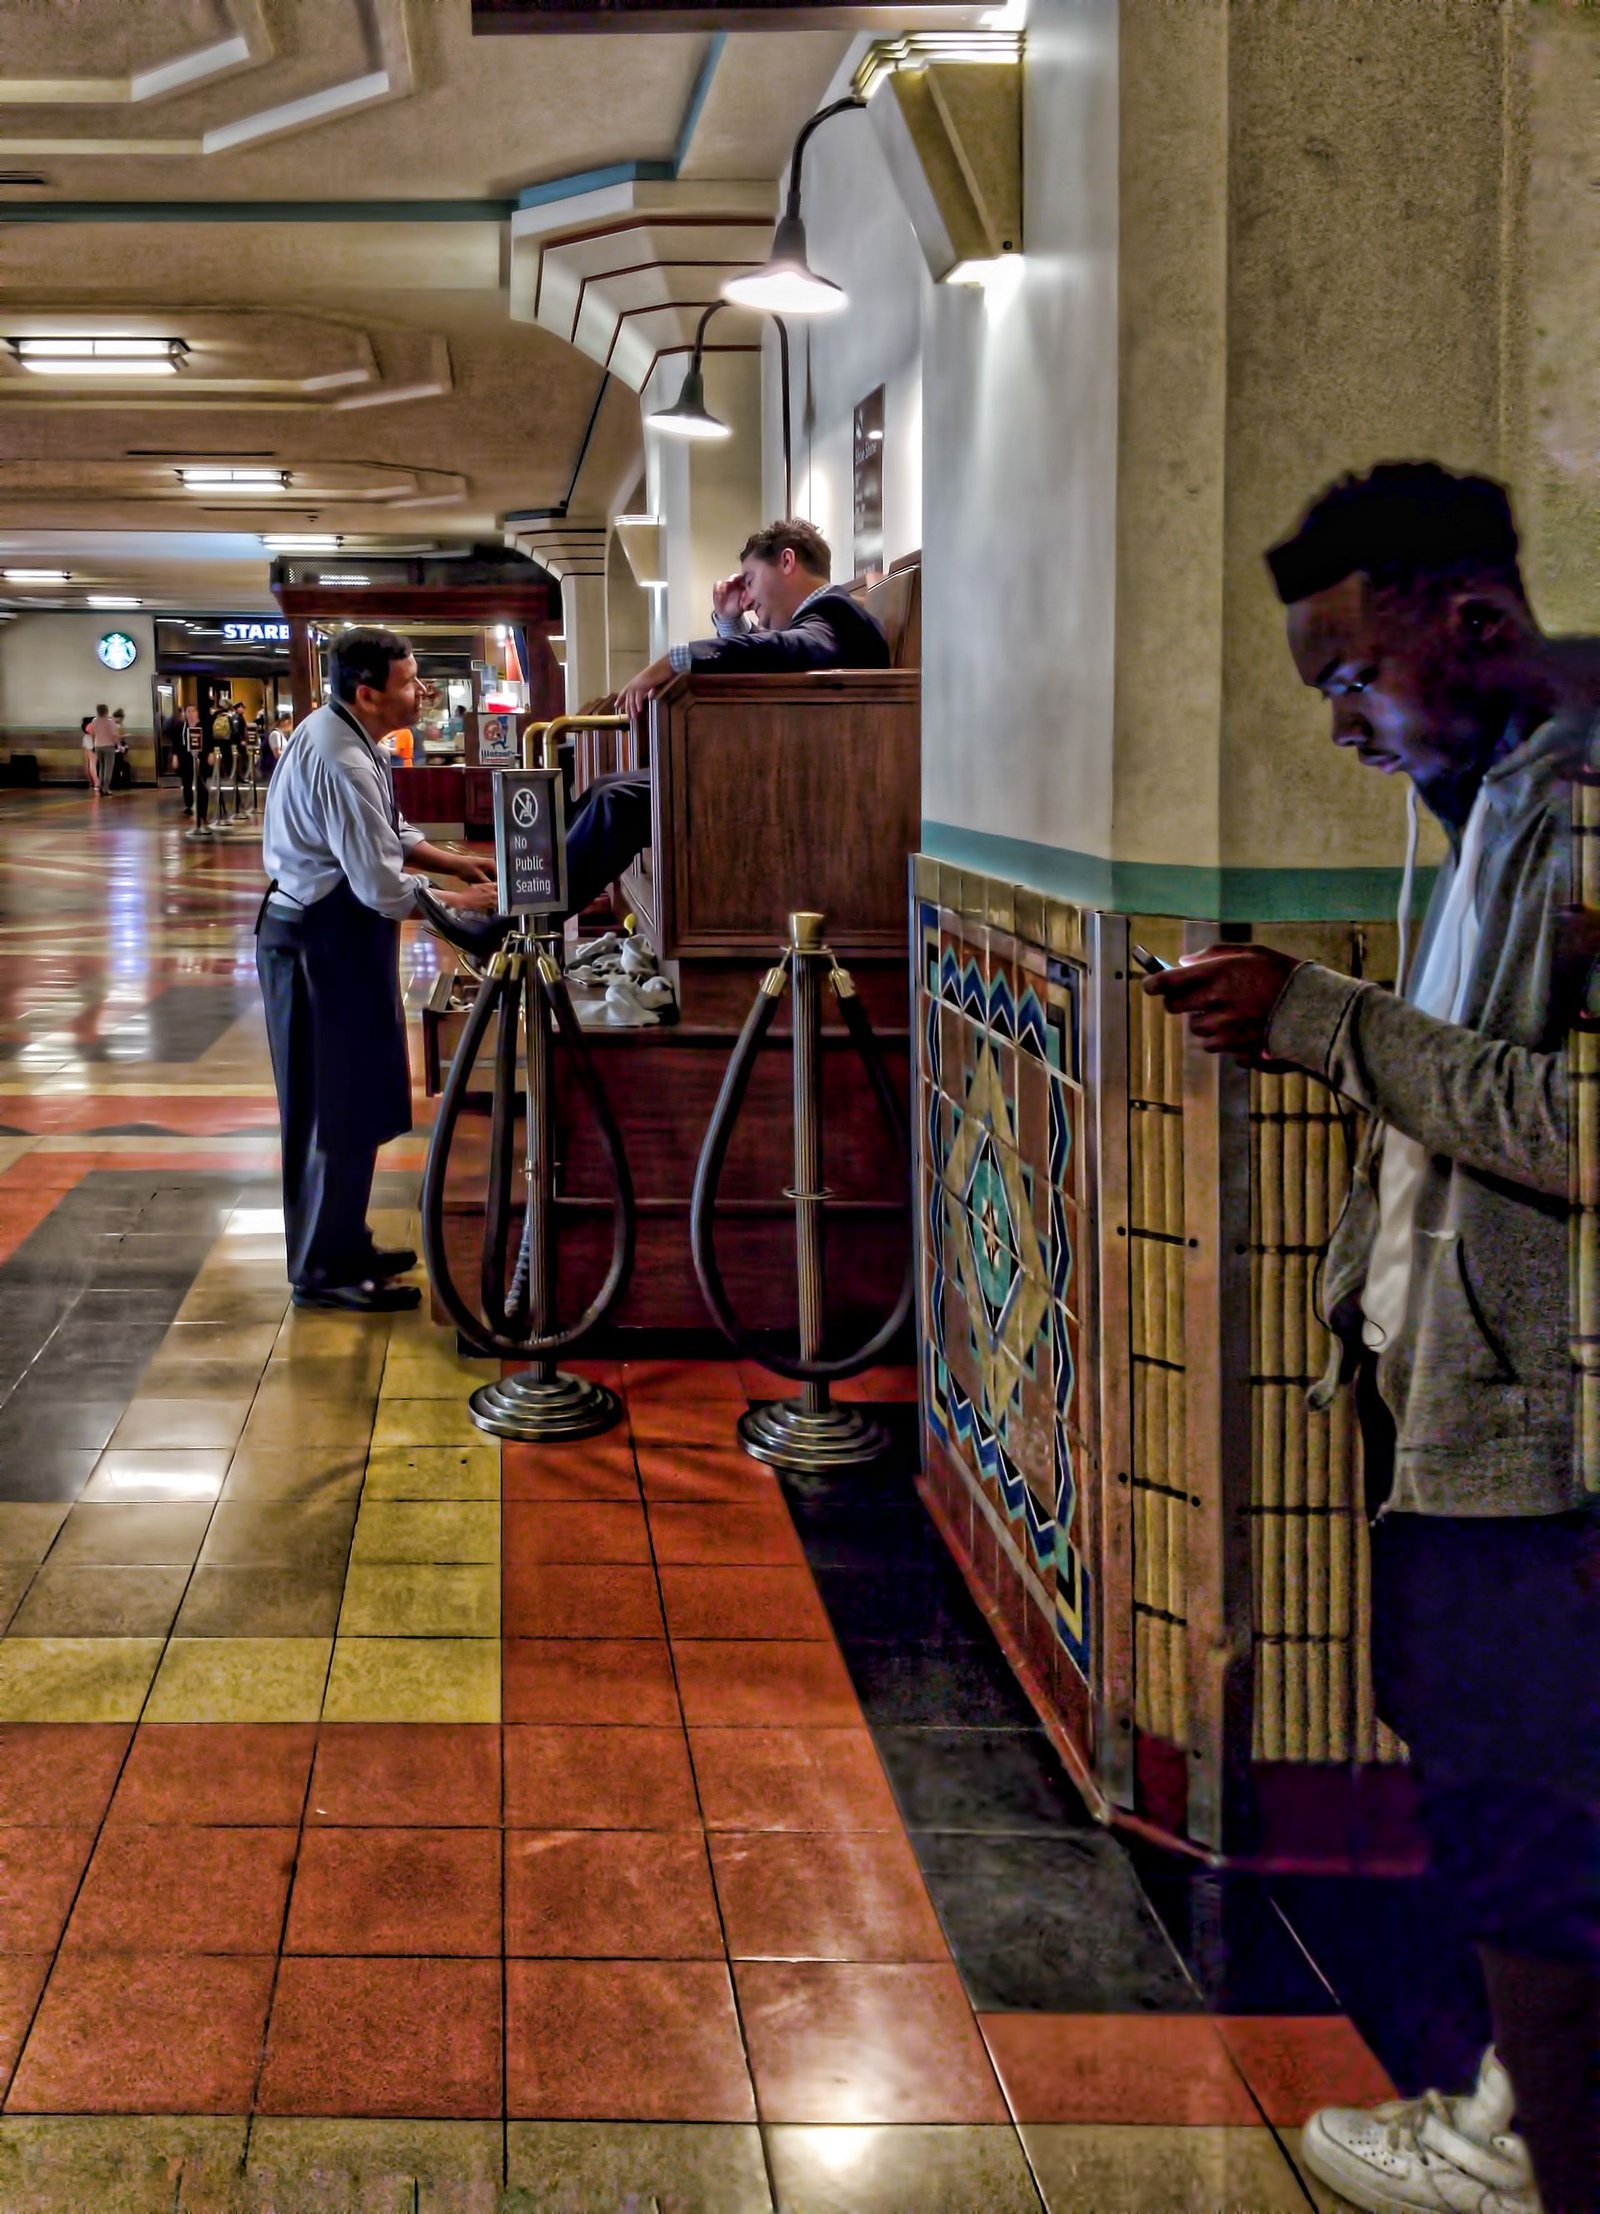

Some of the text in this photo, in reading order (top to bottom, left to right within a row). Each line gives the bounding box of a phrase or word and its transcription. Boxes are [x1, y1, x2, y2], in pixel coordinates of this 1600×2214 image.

[514, 836, 528, 850] No
[515, 856, 544, 872] Public
[516, 877, 551, 894] Seating
